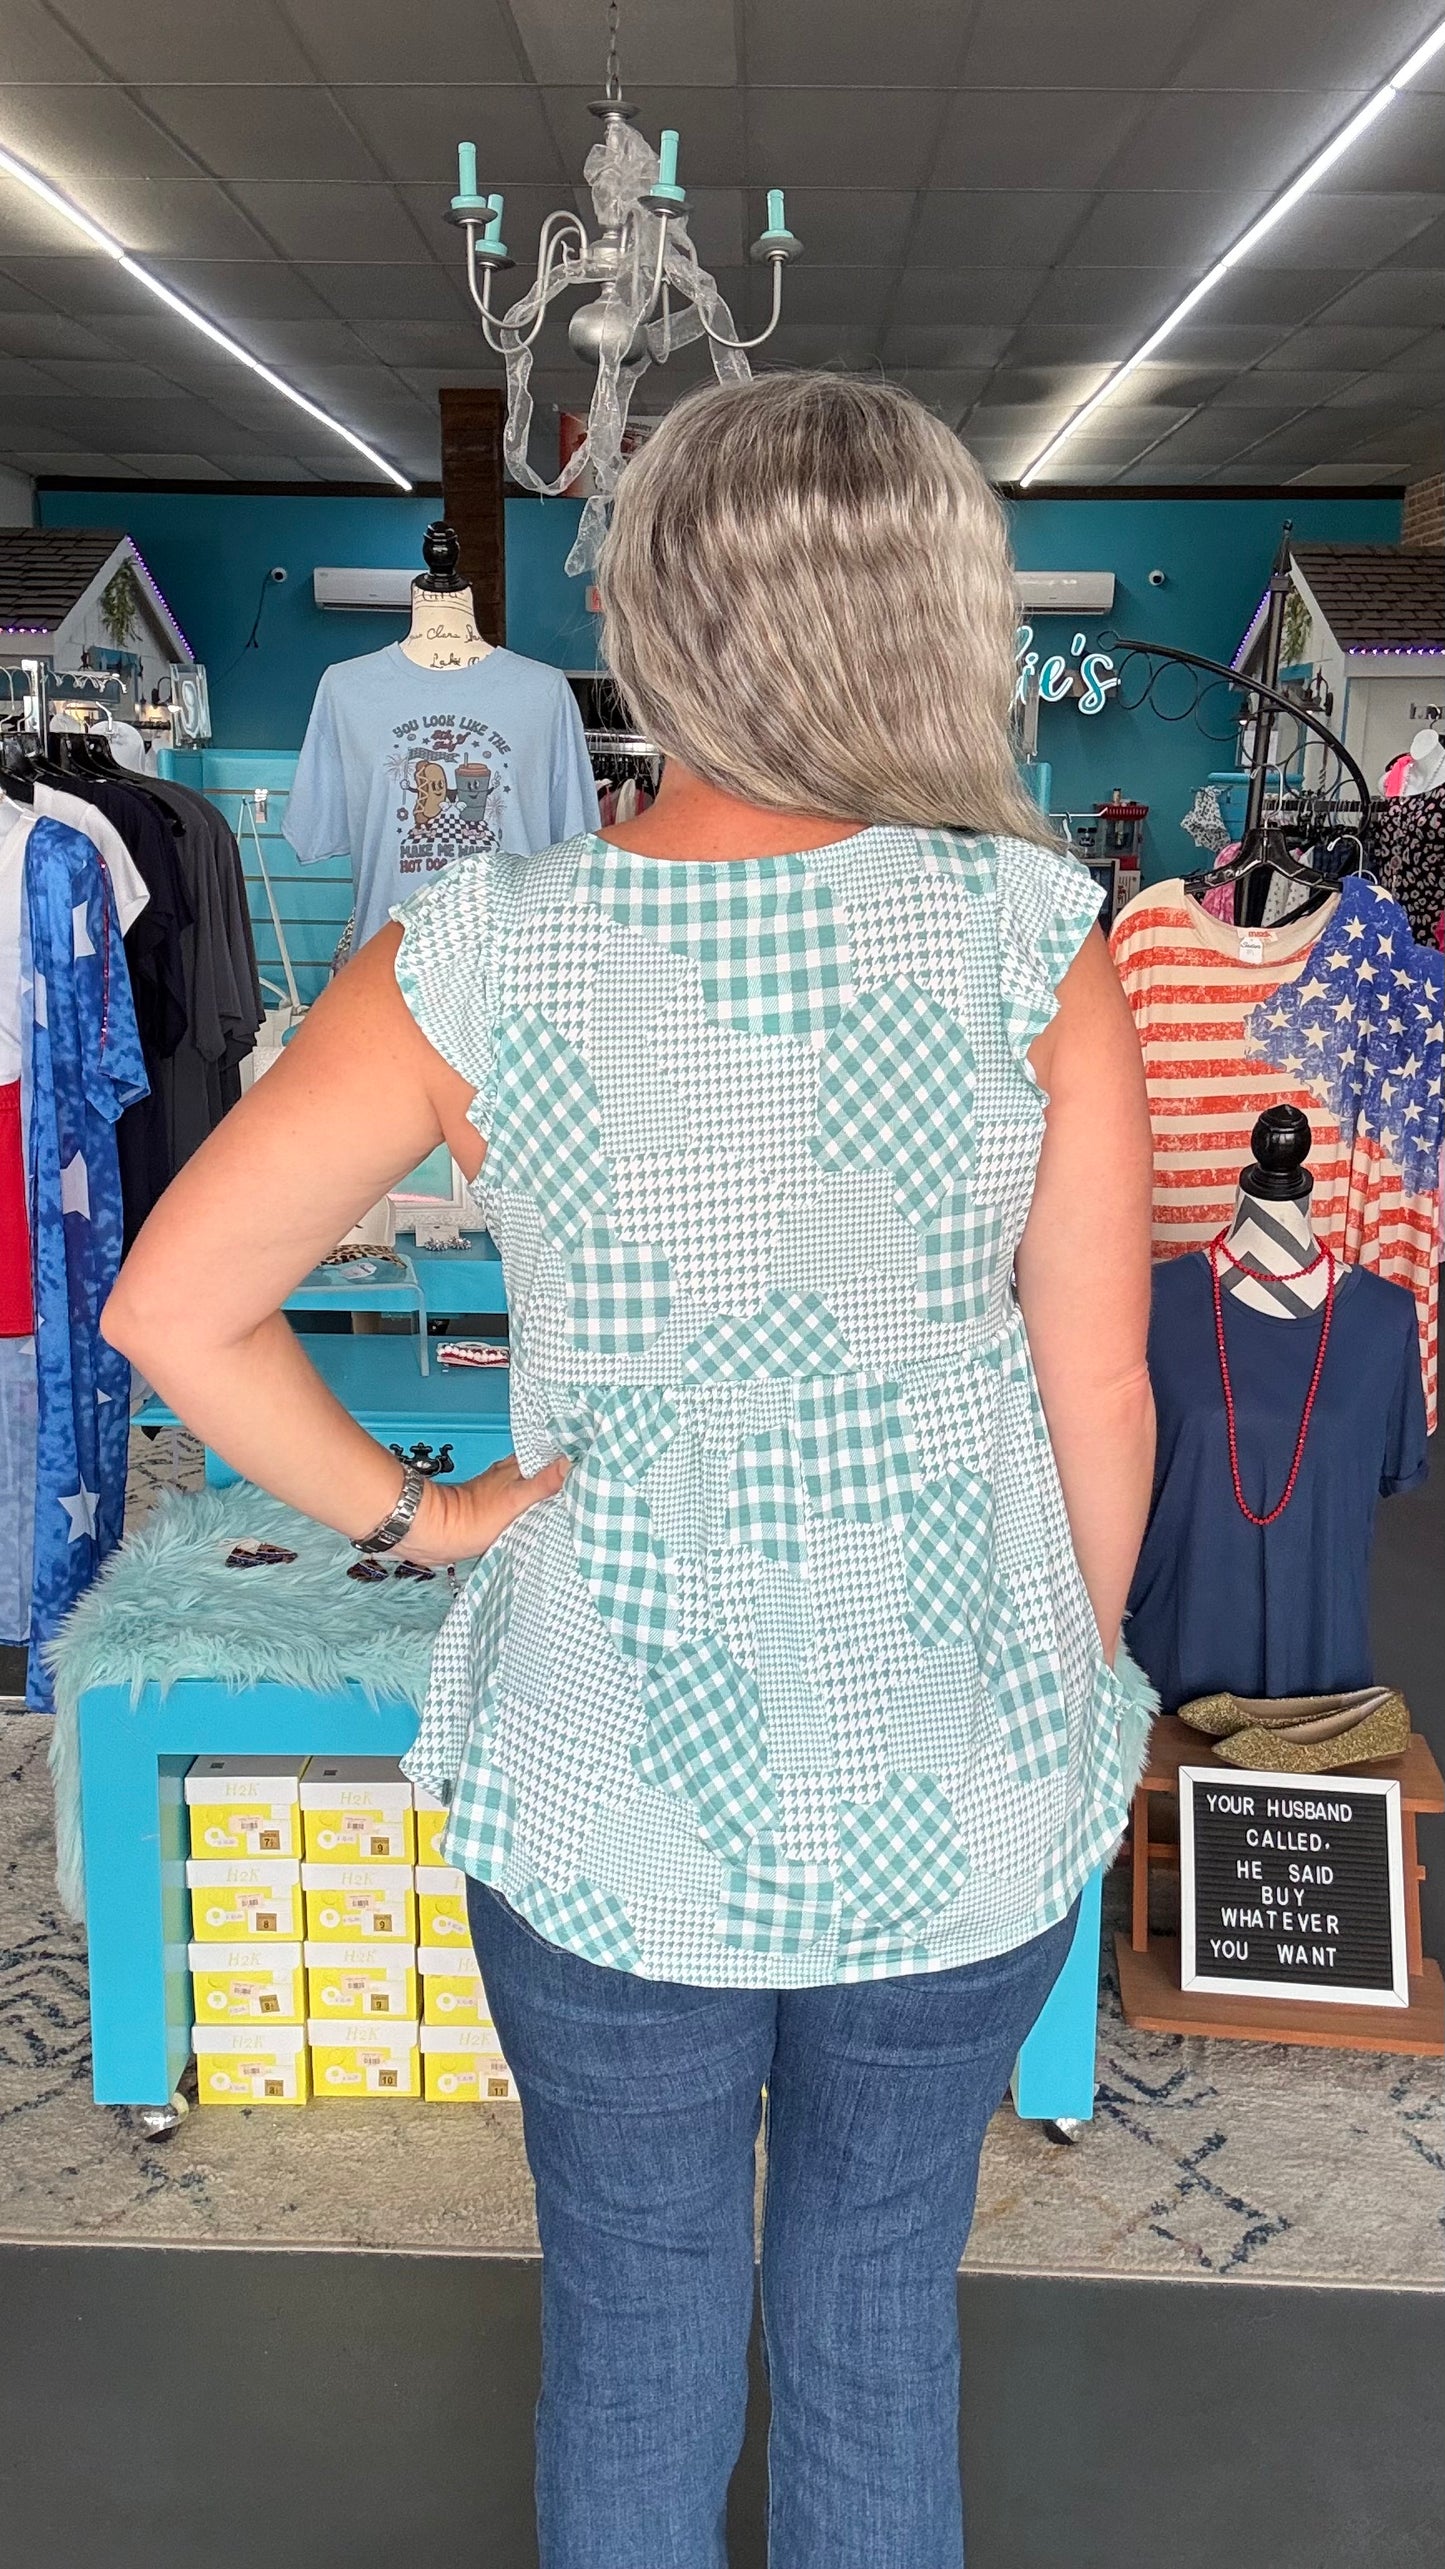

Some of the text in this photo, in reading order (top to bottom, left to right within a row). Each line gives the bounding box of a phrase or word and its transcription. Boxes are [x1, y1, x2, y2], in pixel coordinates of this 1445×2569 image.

[392, 714, 511, 755] YOU LOOK LIKE THE
[400, 844, 433, 859] MAKE
[437, 844, 455, 857] ME
[400, 859, 422, 873] HOT
[1206, 1794, 1352, 1822] YOUR HUSBAND
[377, 1843, 384, 1853] 9
[1236, 1860, 1334, 1885] HE SAID
[1261, 1885, 1305, 1906] BUY
[263, 1920, 269, 1929] 8
[379, 1920, 385, 1929] 9
[1221, 1907, 1339, 1934] WHATEVER
[1210, 1939, 1337, 1967] YOU WANT
[383, 2076, 393, 2085] 10
[494, 2087, 504, 2096] 11
